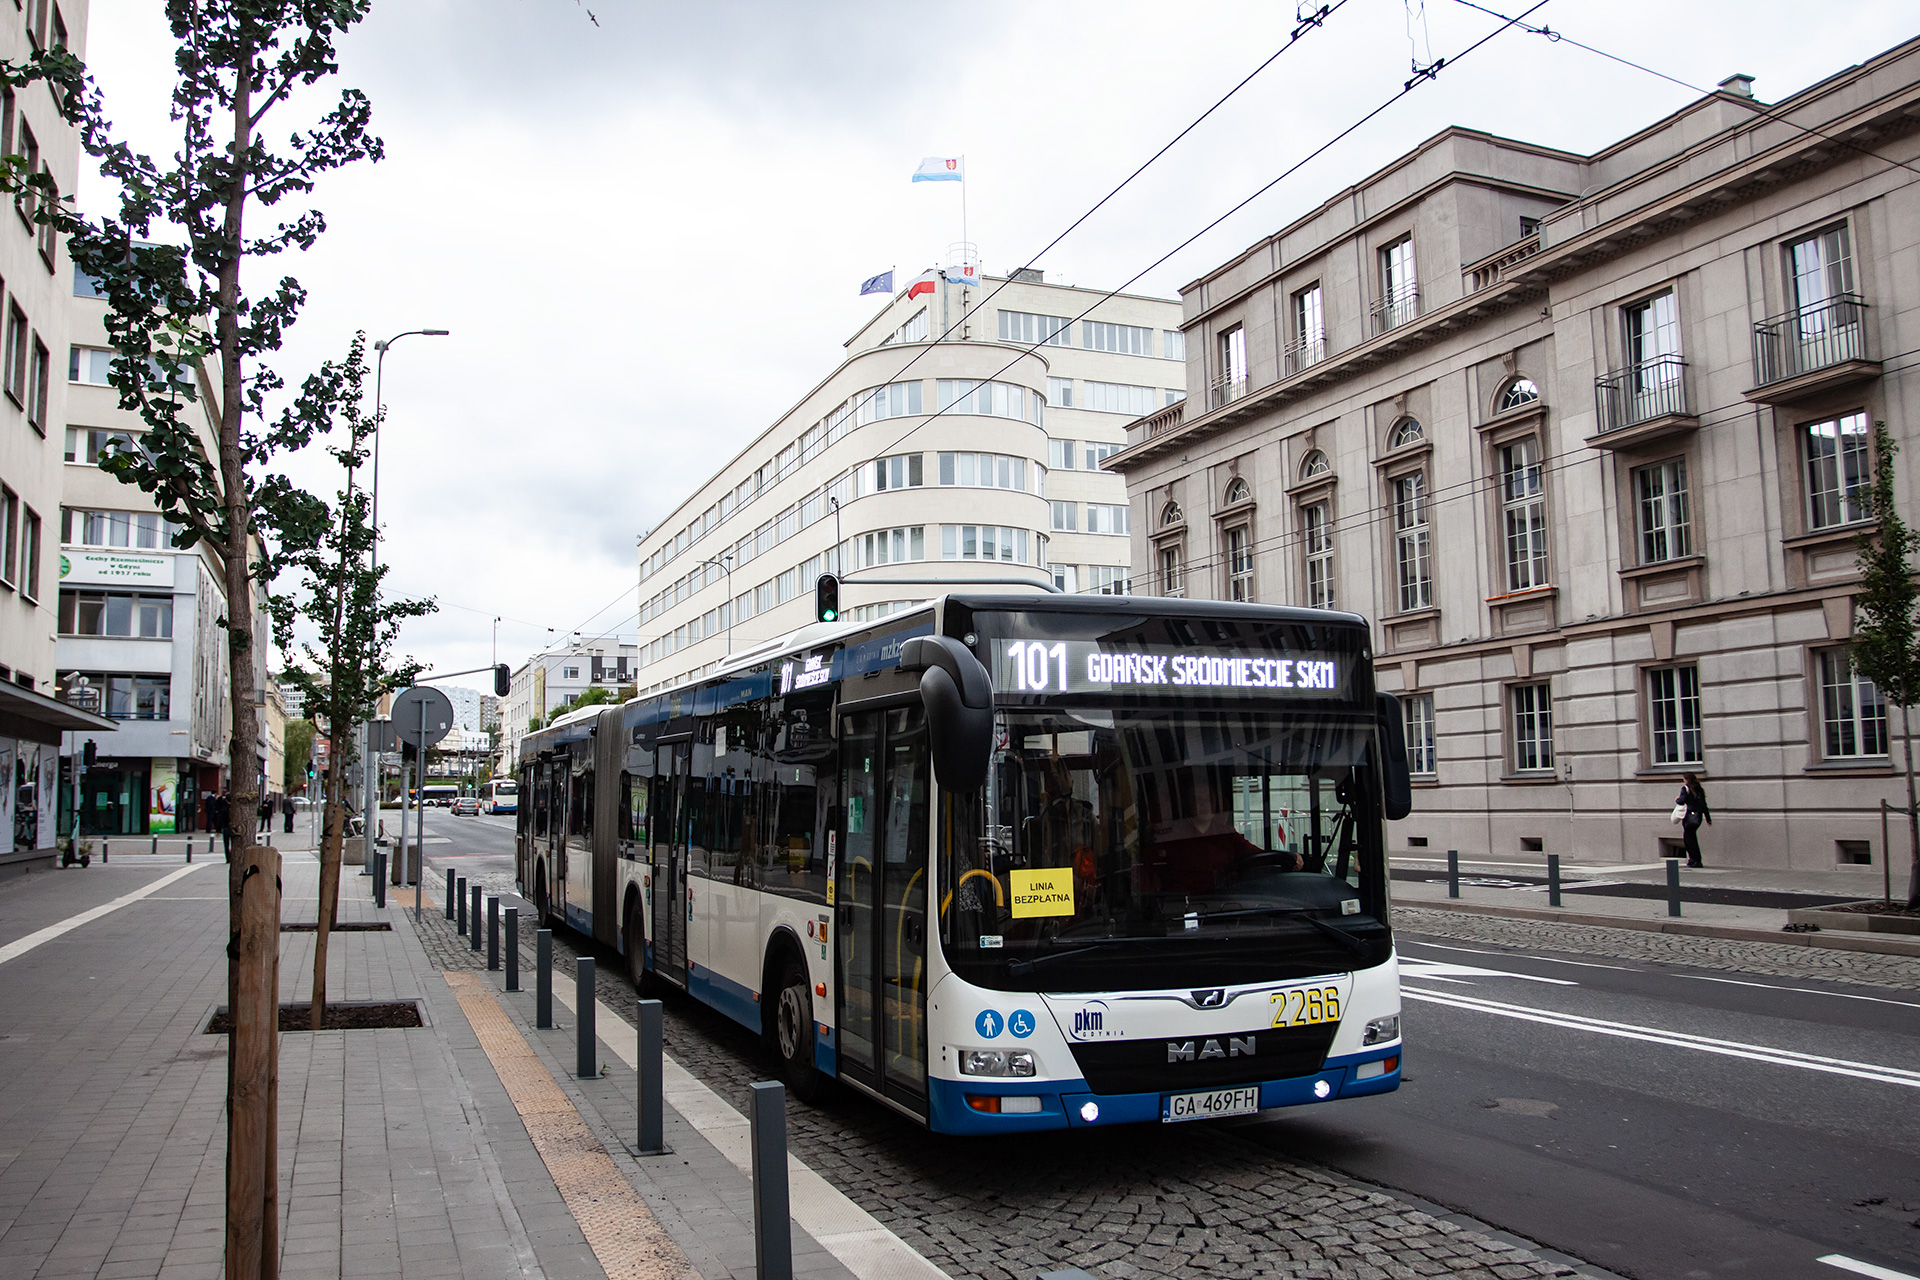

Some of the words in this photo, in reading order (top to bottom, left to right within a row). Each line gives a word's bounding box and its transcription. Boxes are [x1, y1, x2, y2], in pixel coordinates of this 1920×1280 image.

[880, 638, 903, 661] mzkz
[1008, 641, 1067, 691] 101
[1087, 653, 1168, 684] GDAŃSK
[1171, 654, 1294, 688] ŚRÓDMIEŚCIE
[1296, 660, 1335, 689] SKM
[1014, 893, 1071, 904] BEZPŁATNA
[1029, 882, 1054, 891] LINIA
[1270, 986, 1340, 1028] 2266
[1074, 1008, 1103, 1034] pkm
[1166, 1035, 1256, 1063] MAN
[1174, 1096, 1196, 1115] GA
[1203, 1089, 1255, 1112] 469FH
